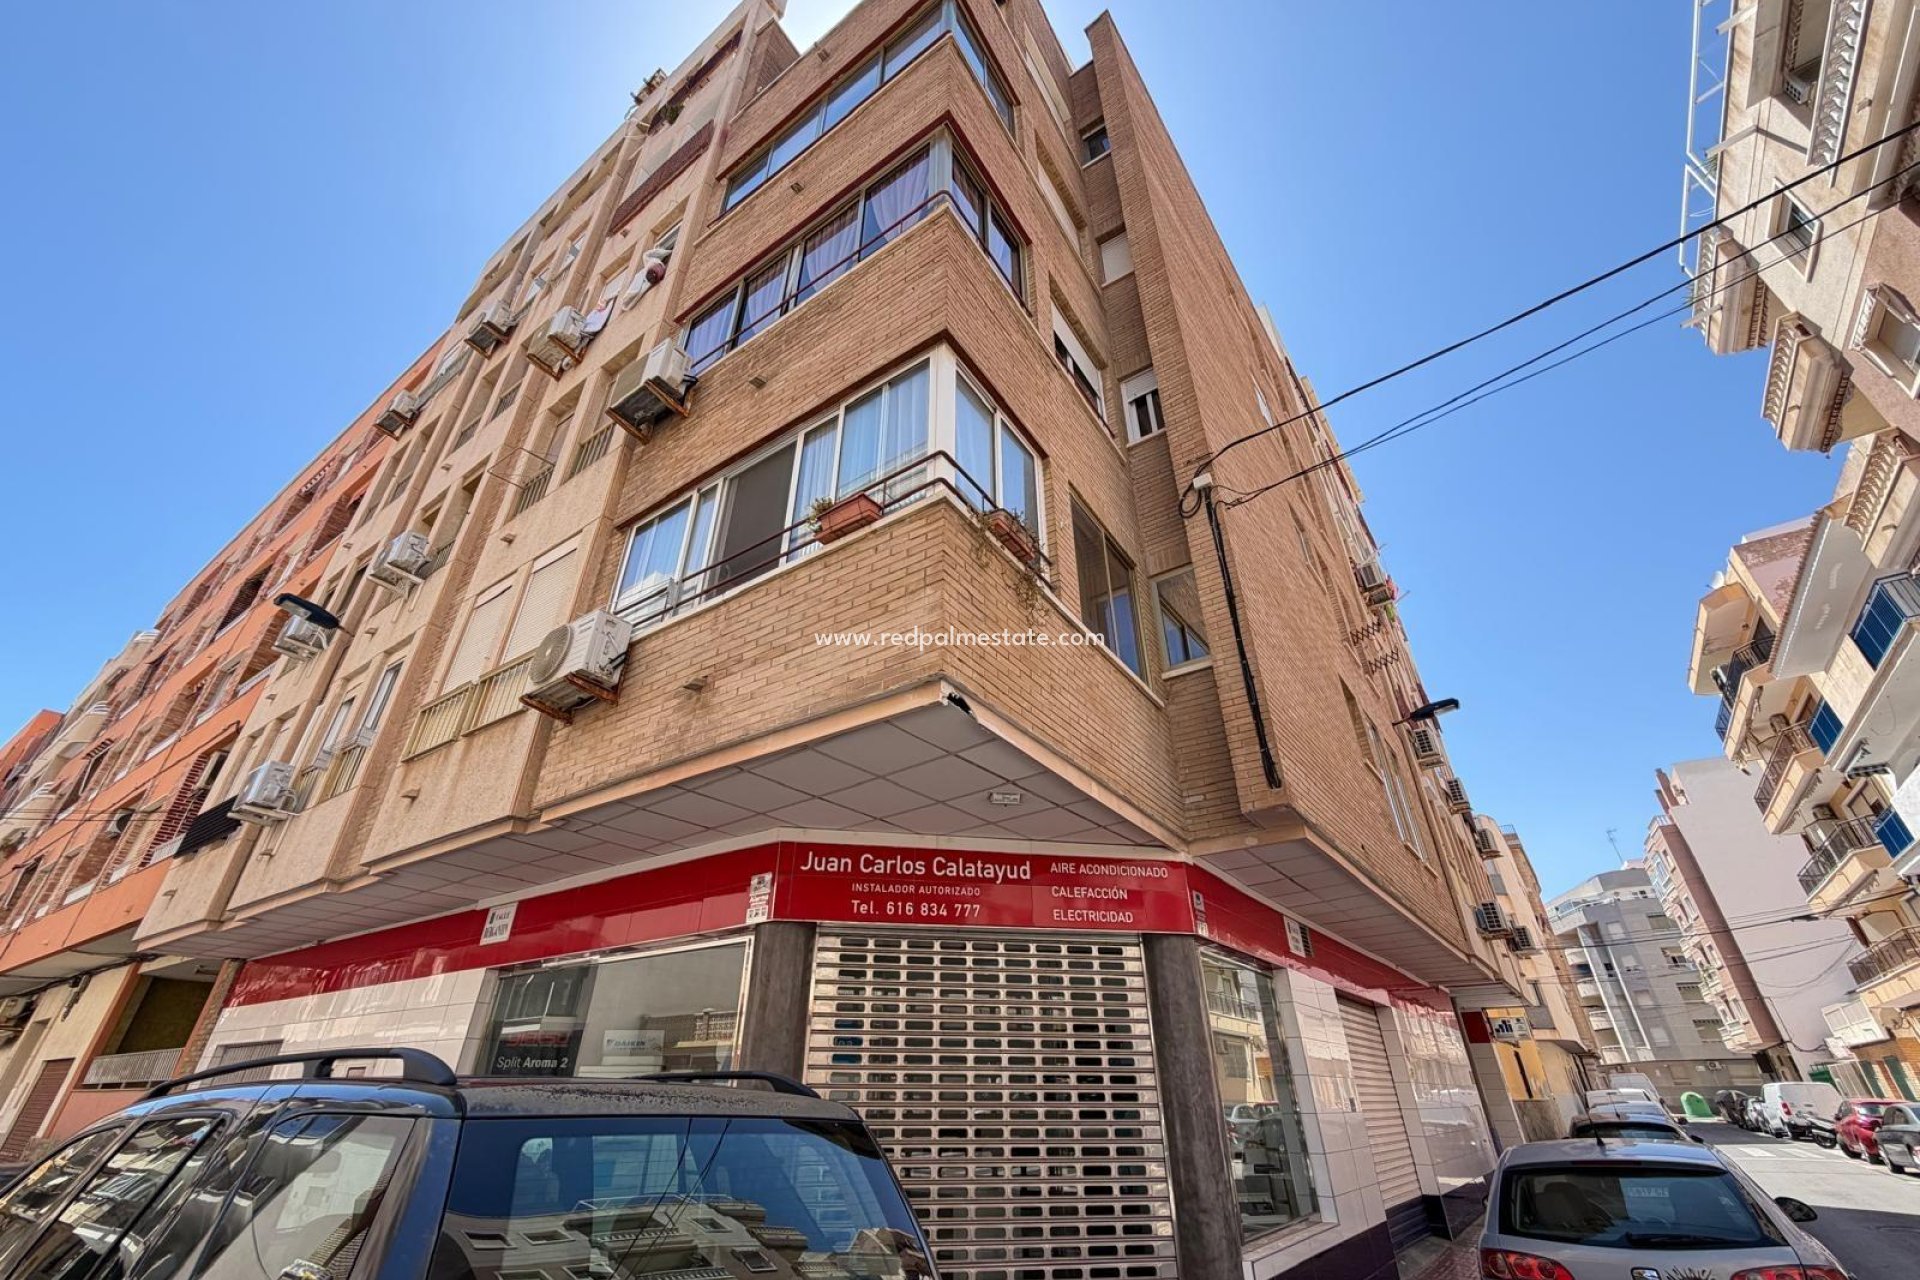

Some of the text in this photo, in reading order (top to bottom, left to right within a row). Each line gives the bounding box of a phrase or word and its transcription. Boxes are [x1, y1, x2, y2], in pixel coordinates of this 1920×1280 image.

[801, 851, 1031, 884] Juan Carlos Calatayud
[1050, 862, 1169, 878] AIRE ACONDICIONADO
[851, 883, 981, 897] INSTALADOR AUTORIZADO
[1051, 885, 1128, 900] CALEFACCIÓN
[851, 900, 981, 918] Tel. 616 834 777
[1053, 909, 1134, 923] ELECTRICIDAD
[497, 1056, 569, 1070] Split Aroma 2
